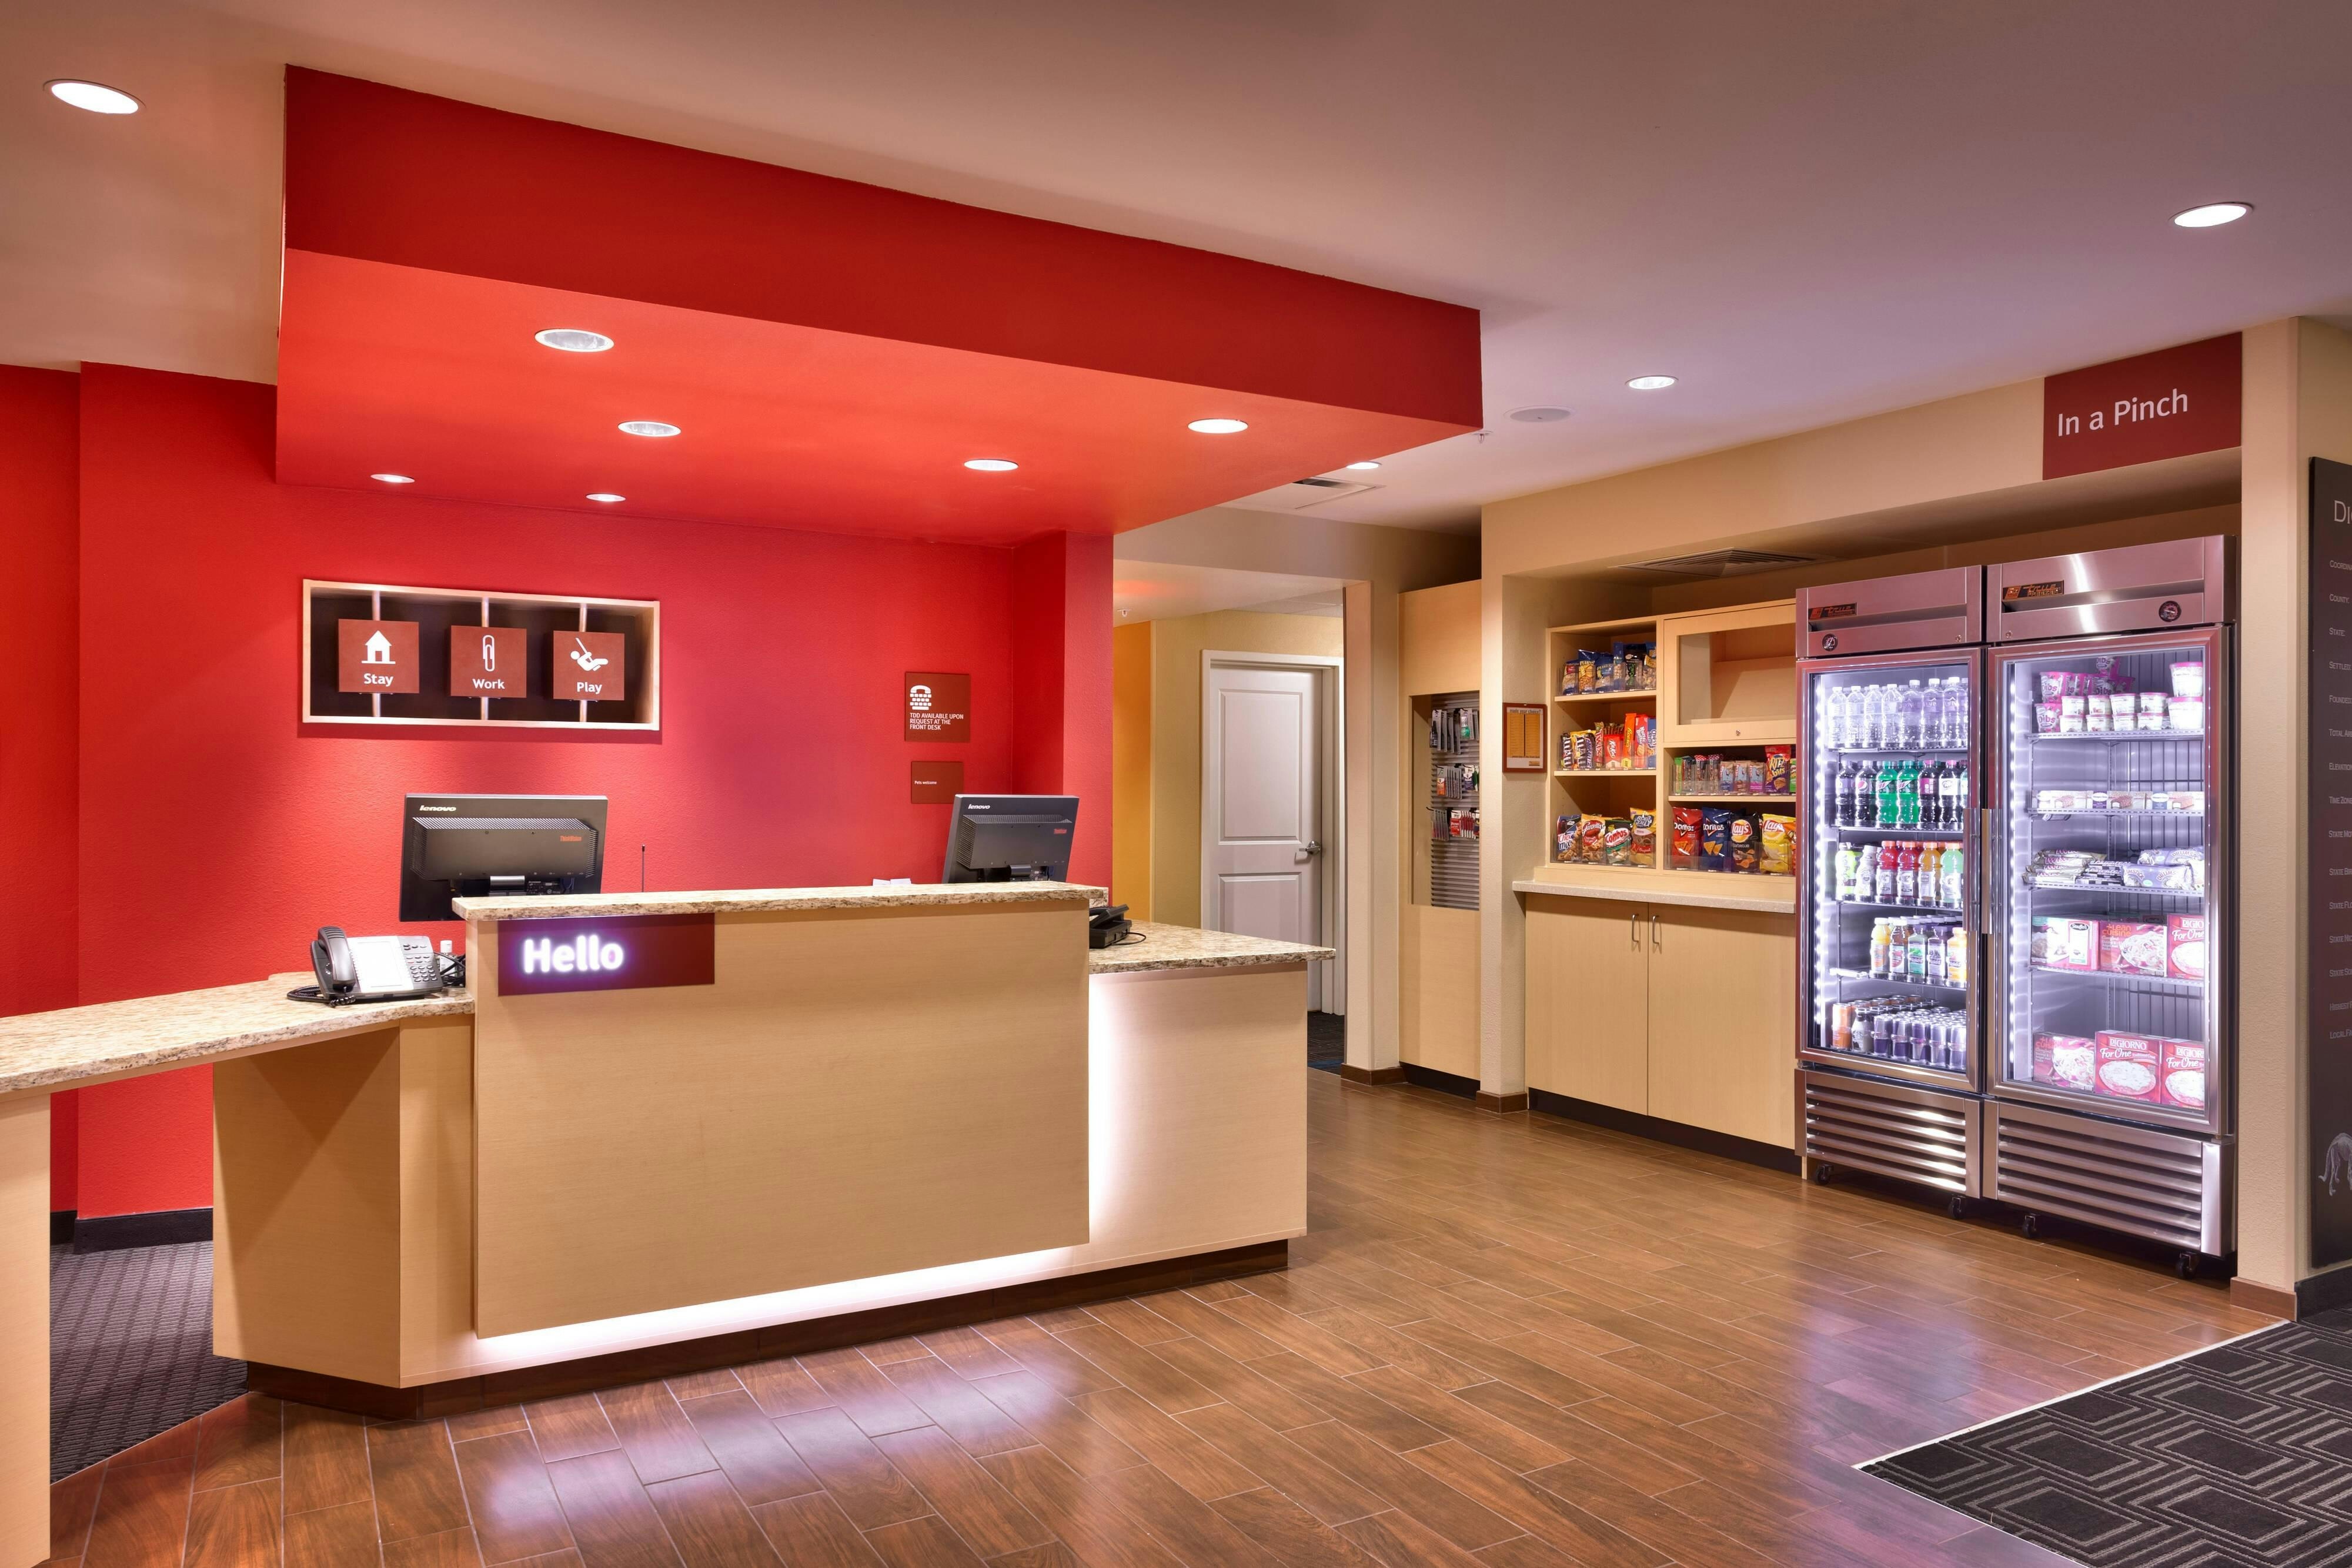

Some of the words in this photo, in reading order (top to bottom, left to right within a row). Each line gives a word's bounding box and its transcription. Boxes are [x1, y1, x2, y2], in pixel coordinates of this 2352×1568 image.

[2058, 413, 2079, 436] In
[2089, 412, 2104, 430] a
[2114, 388, 2188, 426] Pinch
[363, 672, 393, 687] Stay
[472, 678, 505, 690] Work
[577, 681, 603, 694] Play
[2171, 930, 2186, 941] For
[523, 934, 624, 973] Hello
[2100, 1048, 2114, 1058] For
[2114, 1048, 2132, 1058] One
[2166, 1057, 2180, 1068] For
[2181, 1058, 2199, 1068] One
